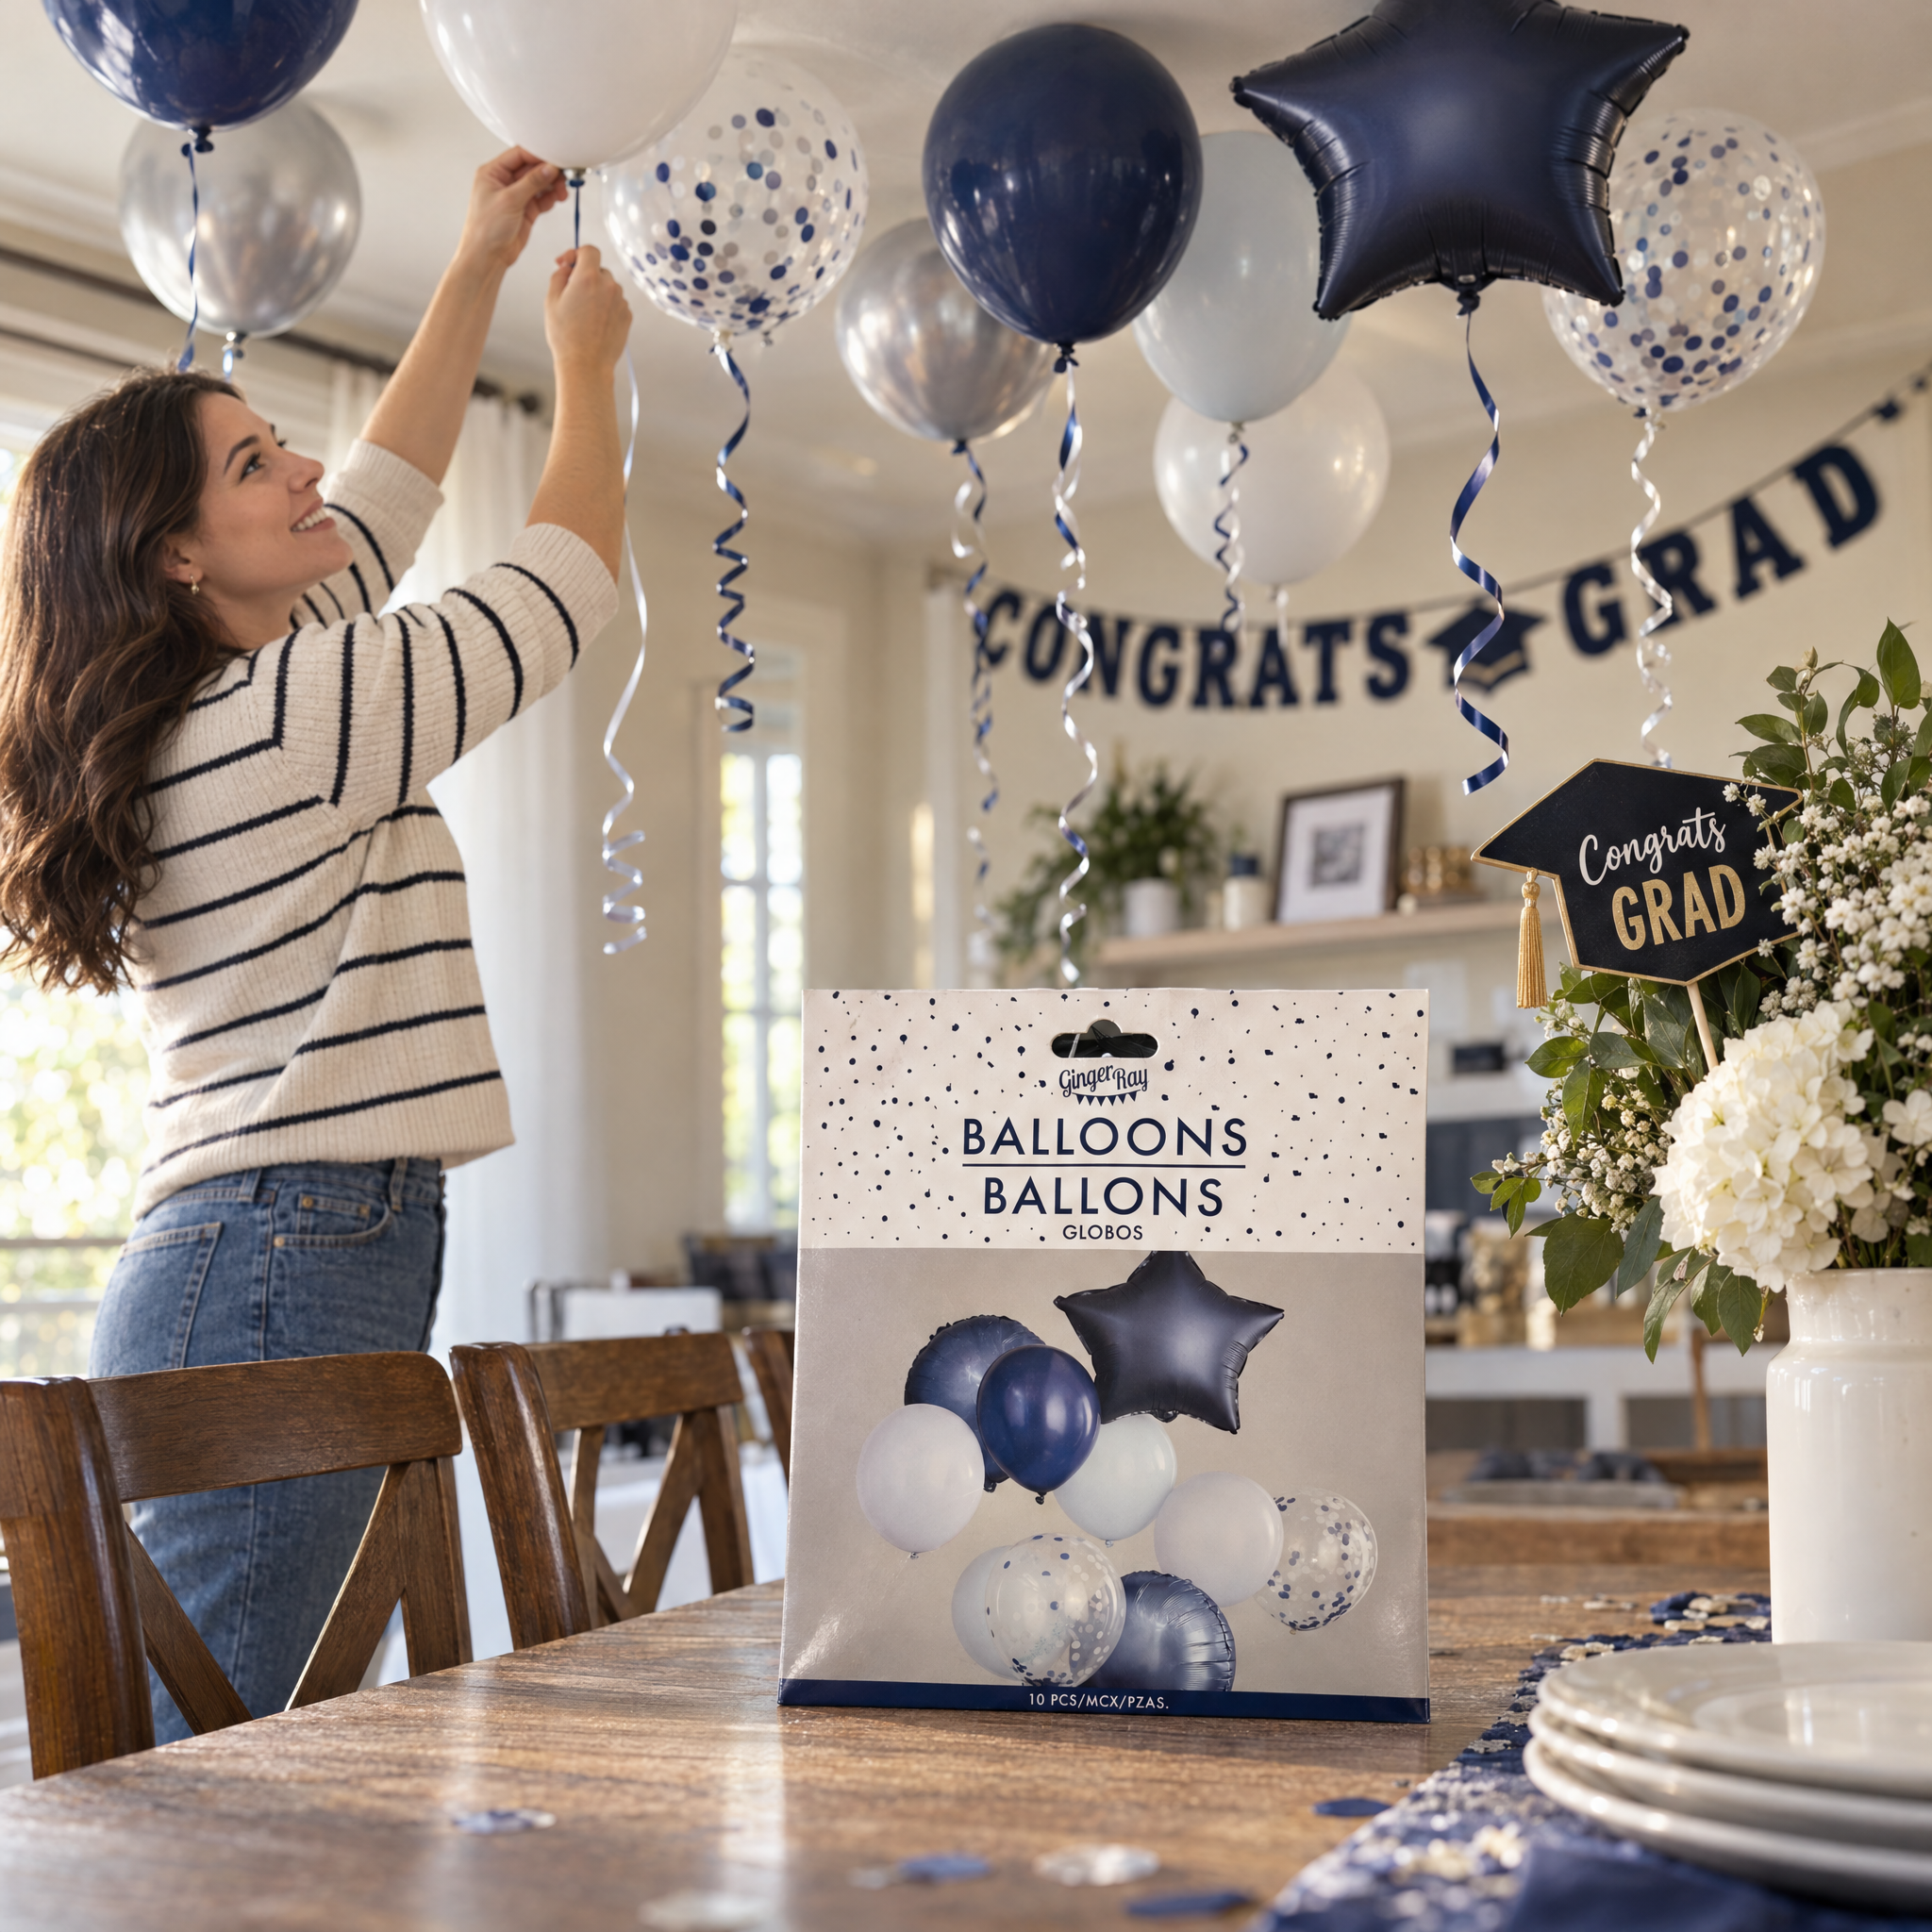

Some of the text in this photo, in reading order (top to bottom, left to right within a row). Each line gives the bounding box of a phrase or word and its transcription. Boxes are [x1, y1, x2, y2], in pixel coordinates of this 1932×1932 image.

[976, 443, 1882, 709] CONGRATS GRAD
[1578, 807, 1726, 886] Congrats
[1611, 864, 1746, 951] GRAD
[1058, 1064, 1148, 1098] Ginger Ray
[962, 1117, 1247, 1158] BALLOONS
[984, 1175, 1223, 1218] BALLONS
[1062, 1224, 1143, 1241] GLOBOS
[1028, 1692, 1170, 1709] 10 PCS/MCX/PZAS.
